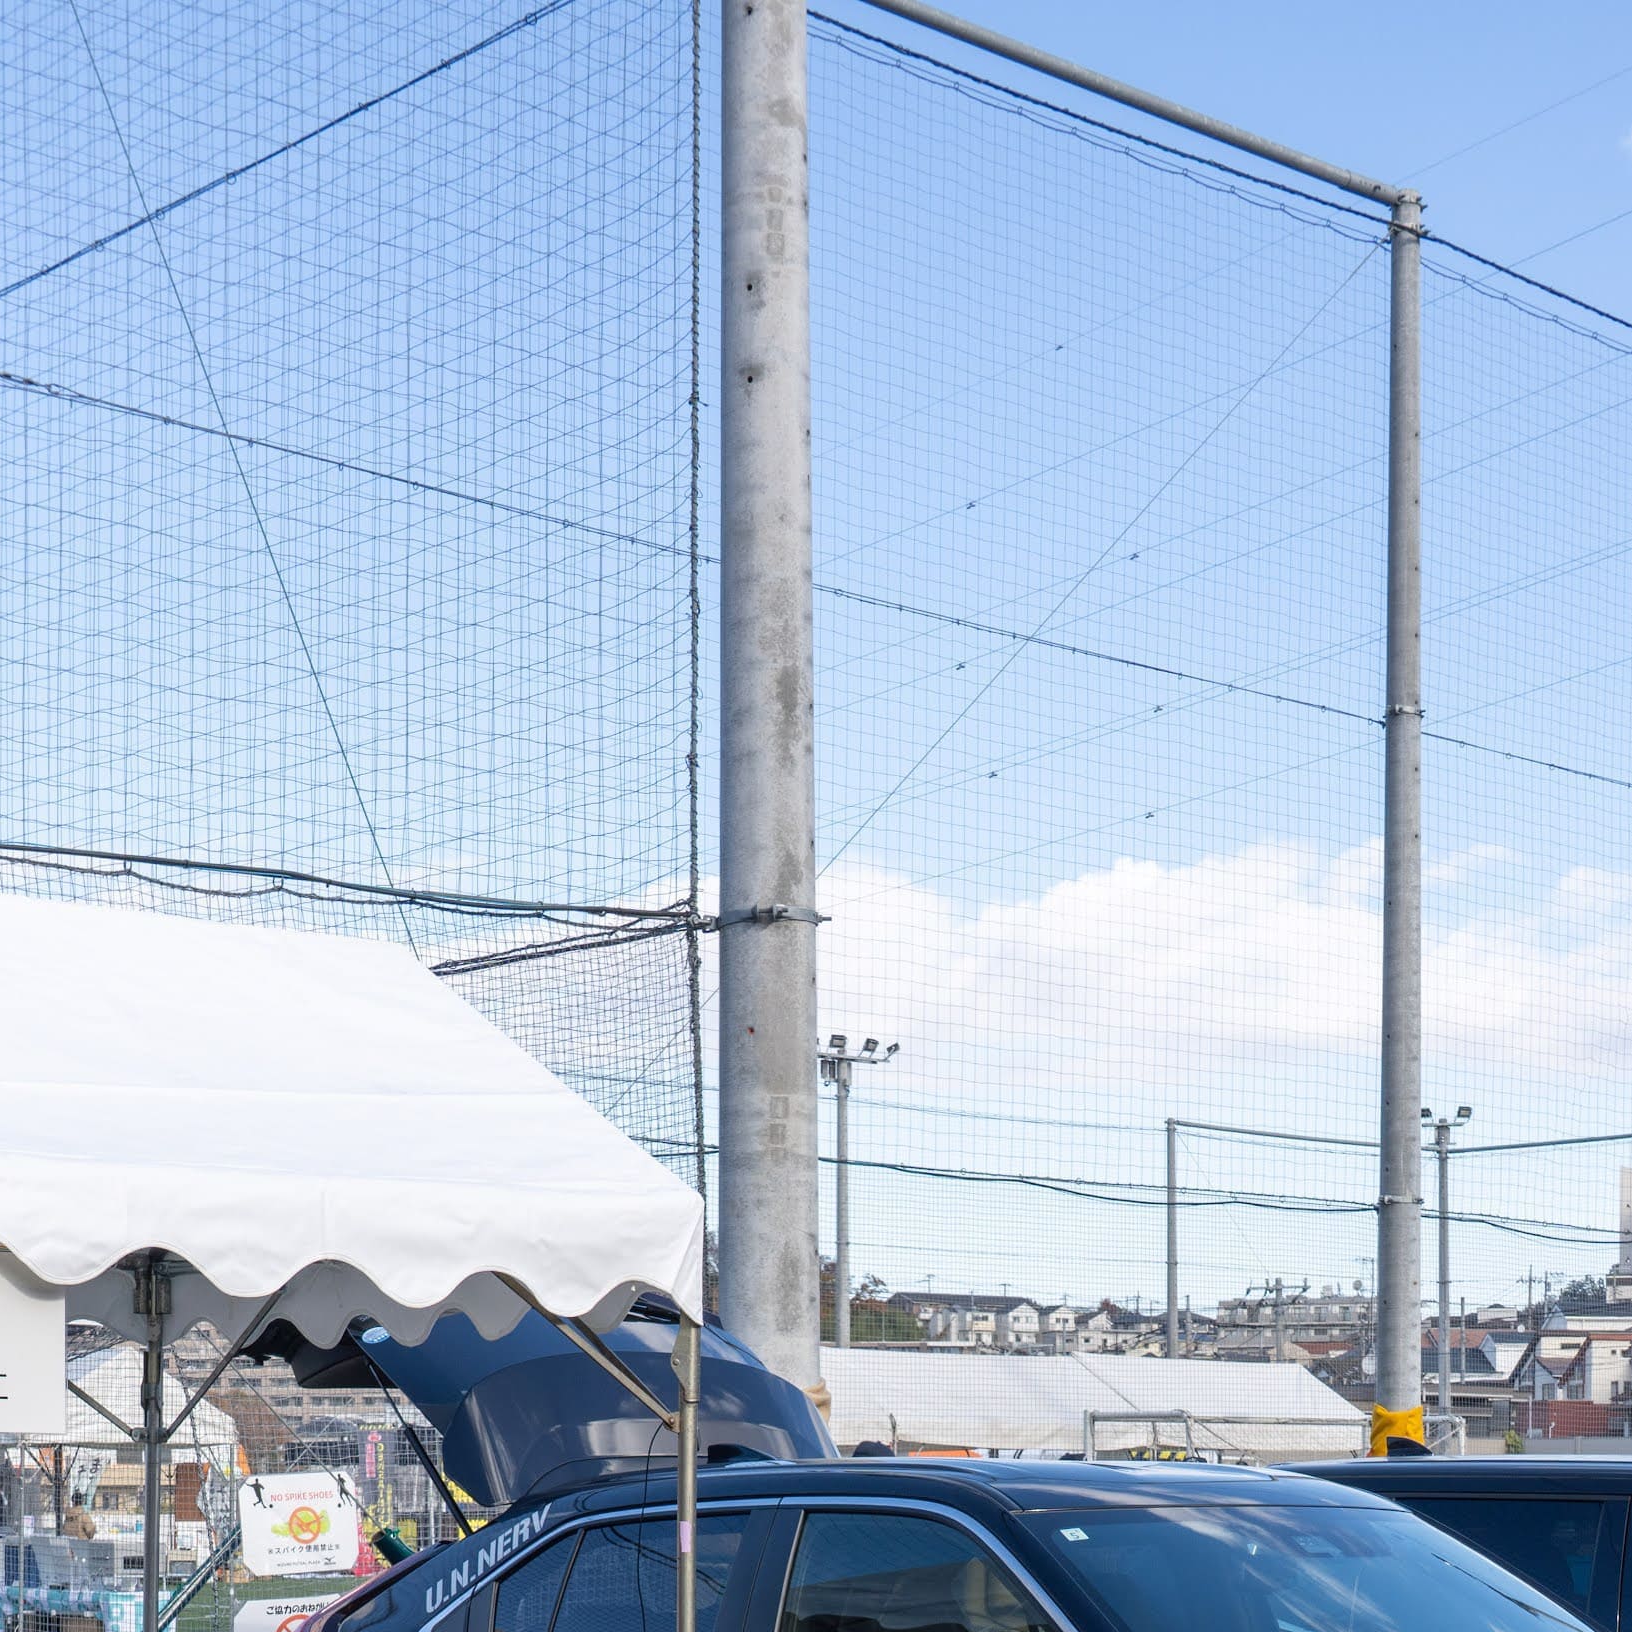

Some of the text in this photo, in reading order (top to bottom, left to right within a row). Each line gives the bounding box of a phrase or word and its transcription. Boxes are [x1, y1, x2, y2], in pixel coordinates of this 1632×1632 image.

[270, 1490, 334, 1502] NO SPIKE SHOES
